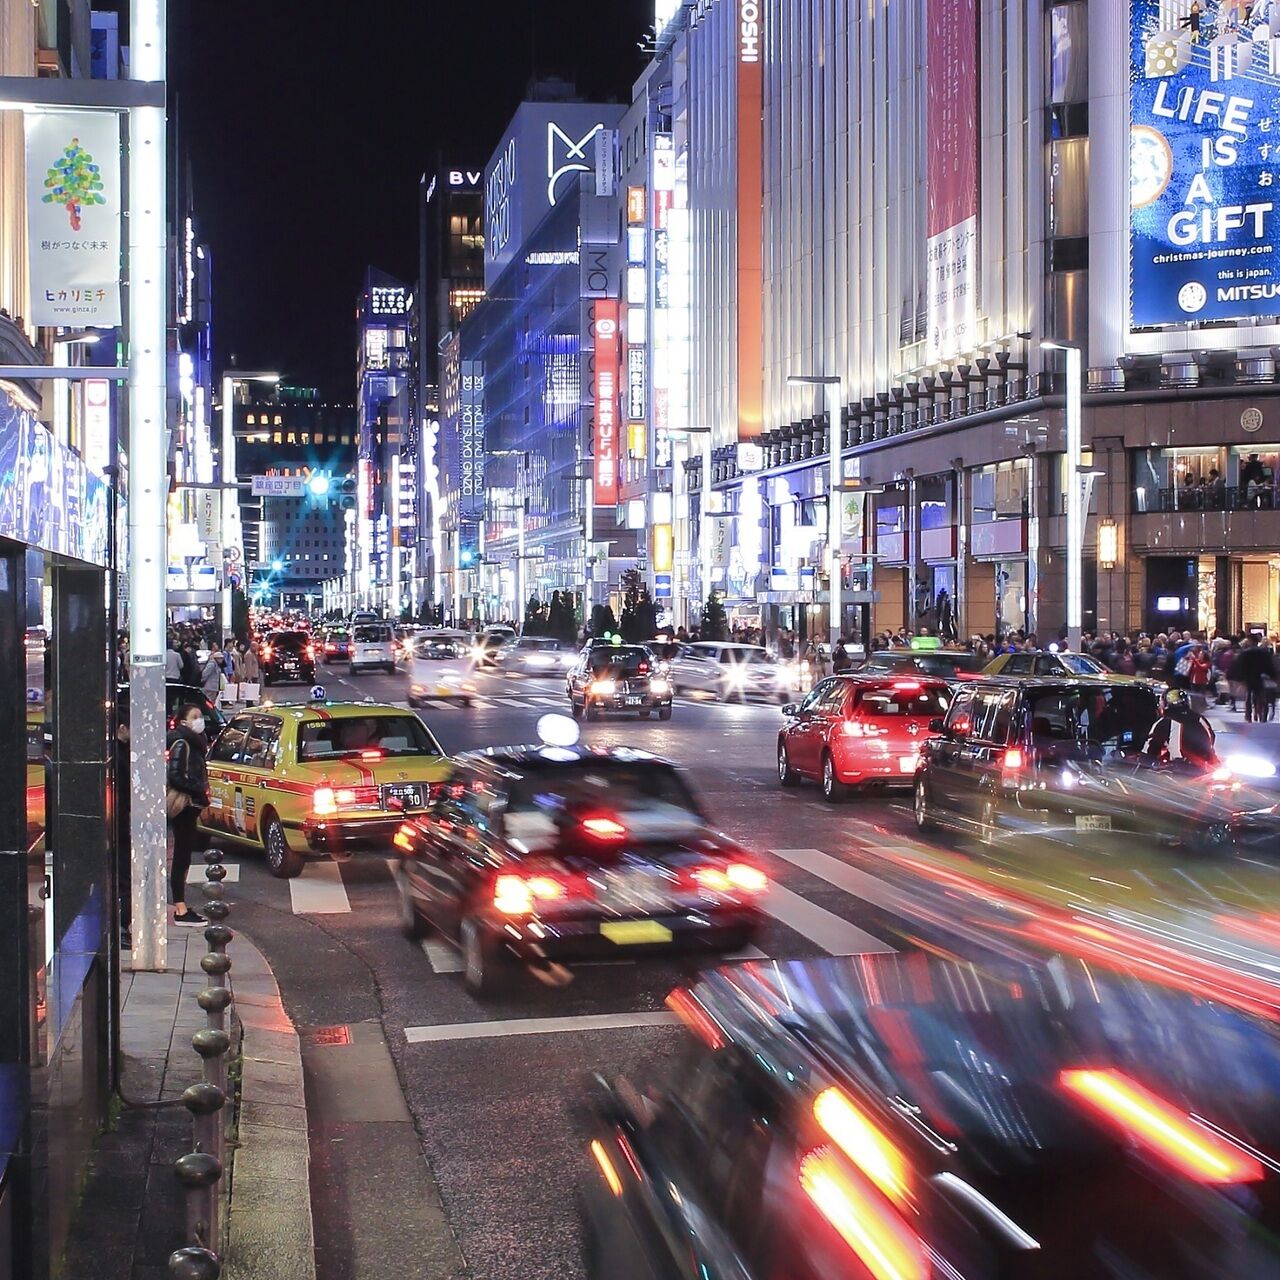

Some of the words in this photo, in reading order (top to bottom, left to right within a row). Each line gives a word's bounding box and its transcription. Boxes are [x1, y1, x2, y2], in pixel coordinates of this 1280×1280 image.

[1151, 80, 1254, 135] LIFE
[1201, 134, 1238, 169] IS
[1185, 174, 1213, 206] A
[1166, 201, 1274, 246] GIFT
[40, 239, 109, 253] 樹がつなぐ未来
[1152, 242, 1273, 264] christmas-journey.com
[1217, 269, 1234, 280] this
[1236, 268, 1244, 279] is
[1246, 266, 1273, 281] japan.
[45, 288, 107, 303] ヒカリミチ
[52, 305, 99, 315] www.ginza.jp
